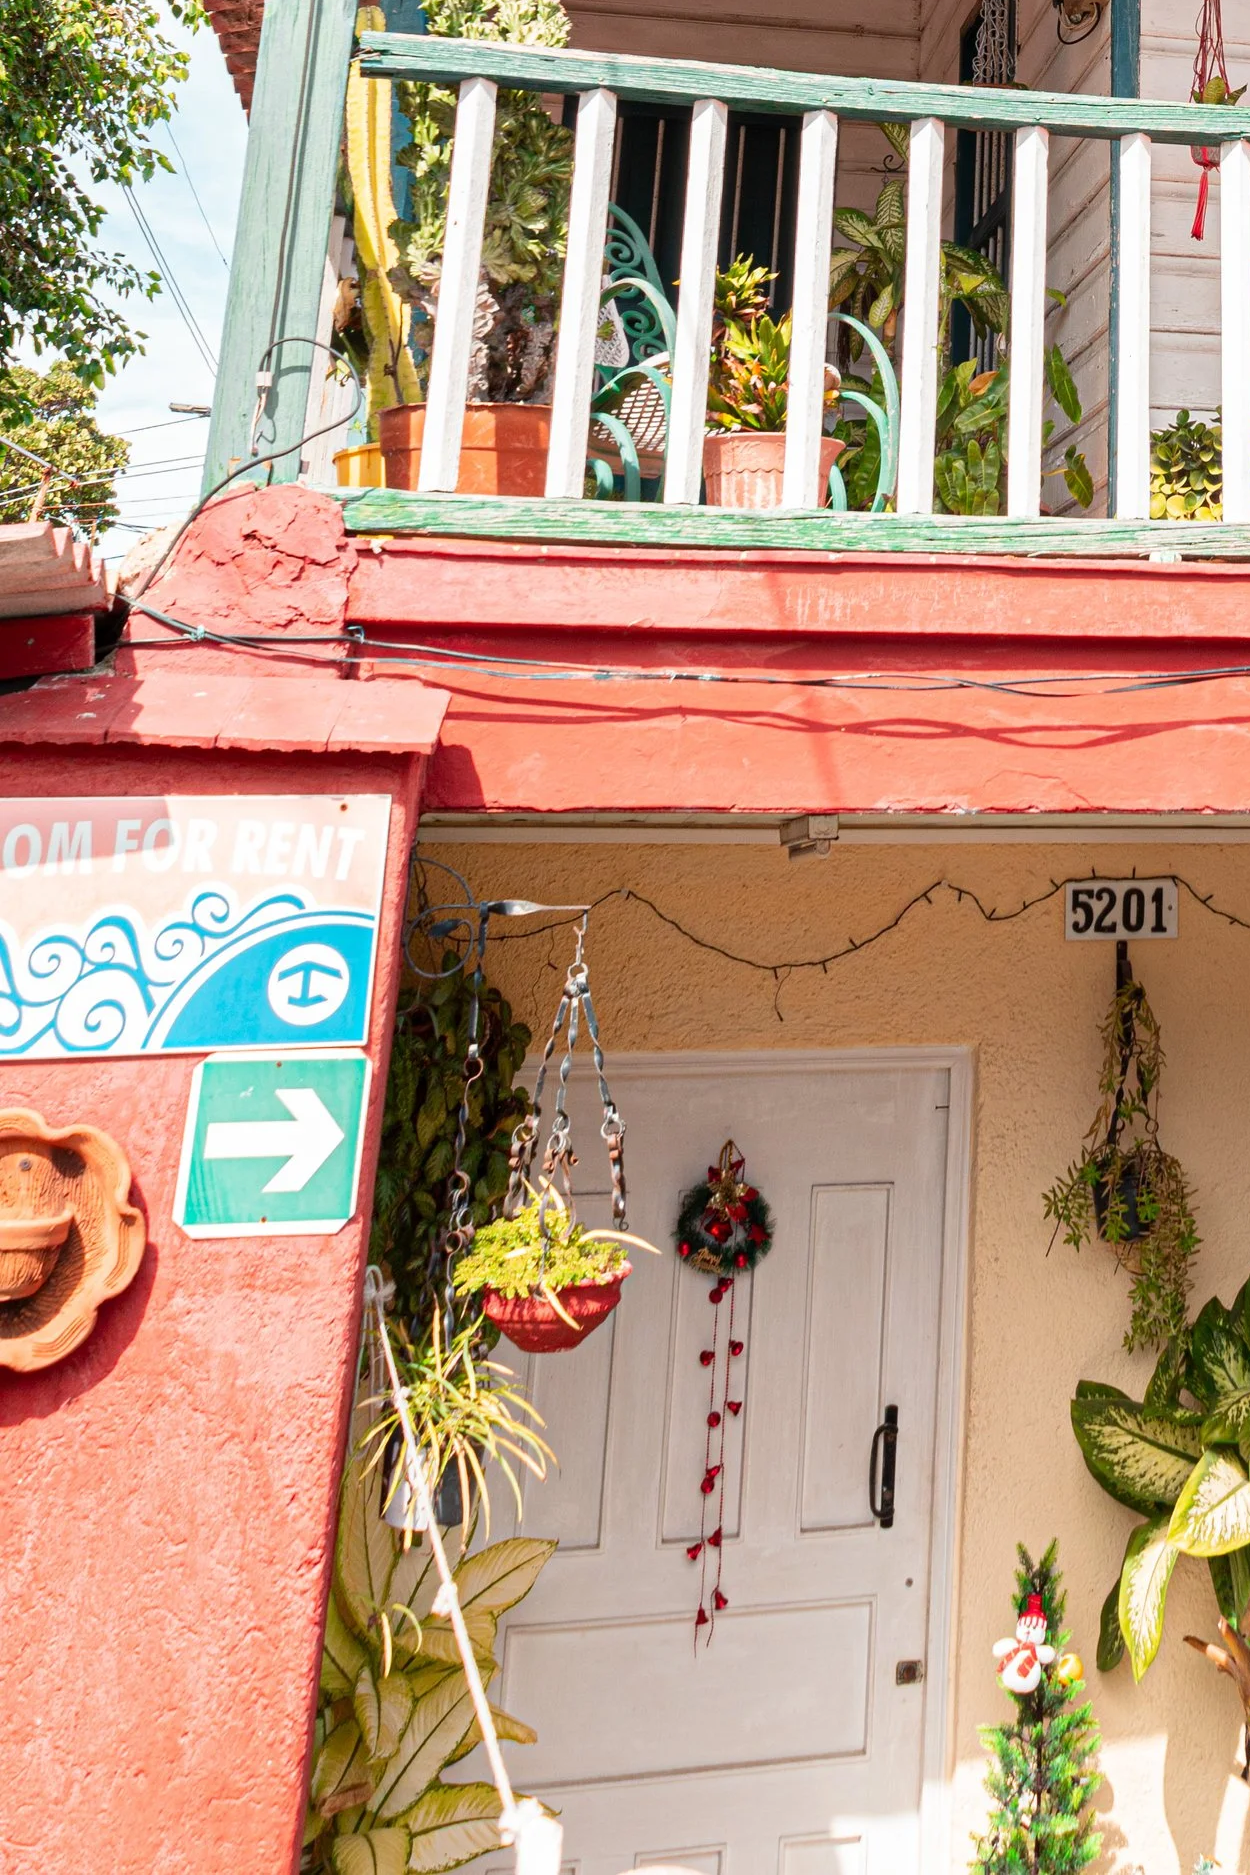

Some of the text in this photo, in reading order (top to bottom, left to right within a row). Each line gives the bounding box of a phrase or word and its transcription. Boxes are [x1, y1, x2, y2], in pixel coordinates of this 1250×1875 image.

[111, 817, 227, 874] FOR
[232, 818, 366, 881] RENT
[1071, 887, 1168, 934] 5201
